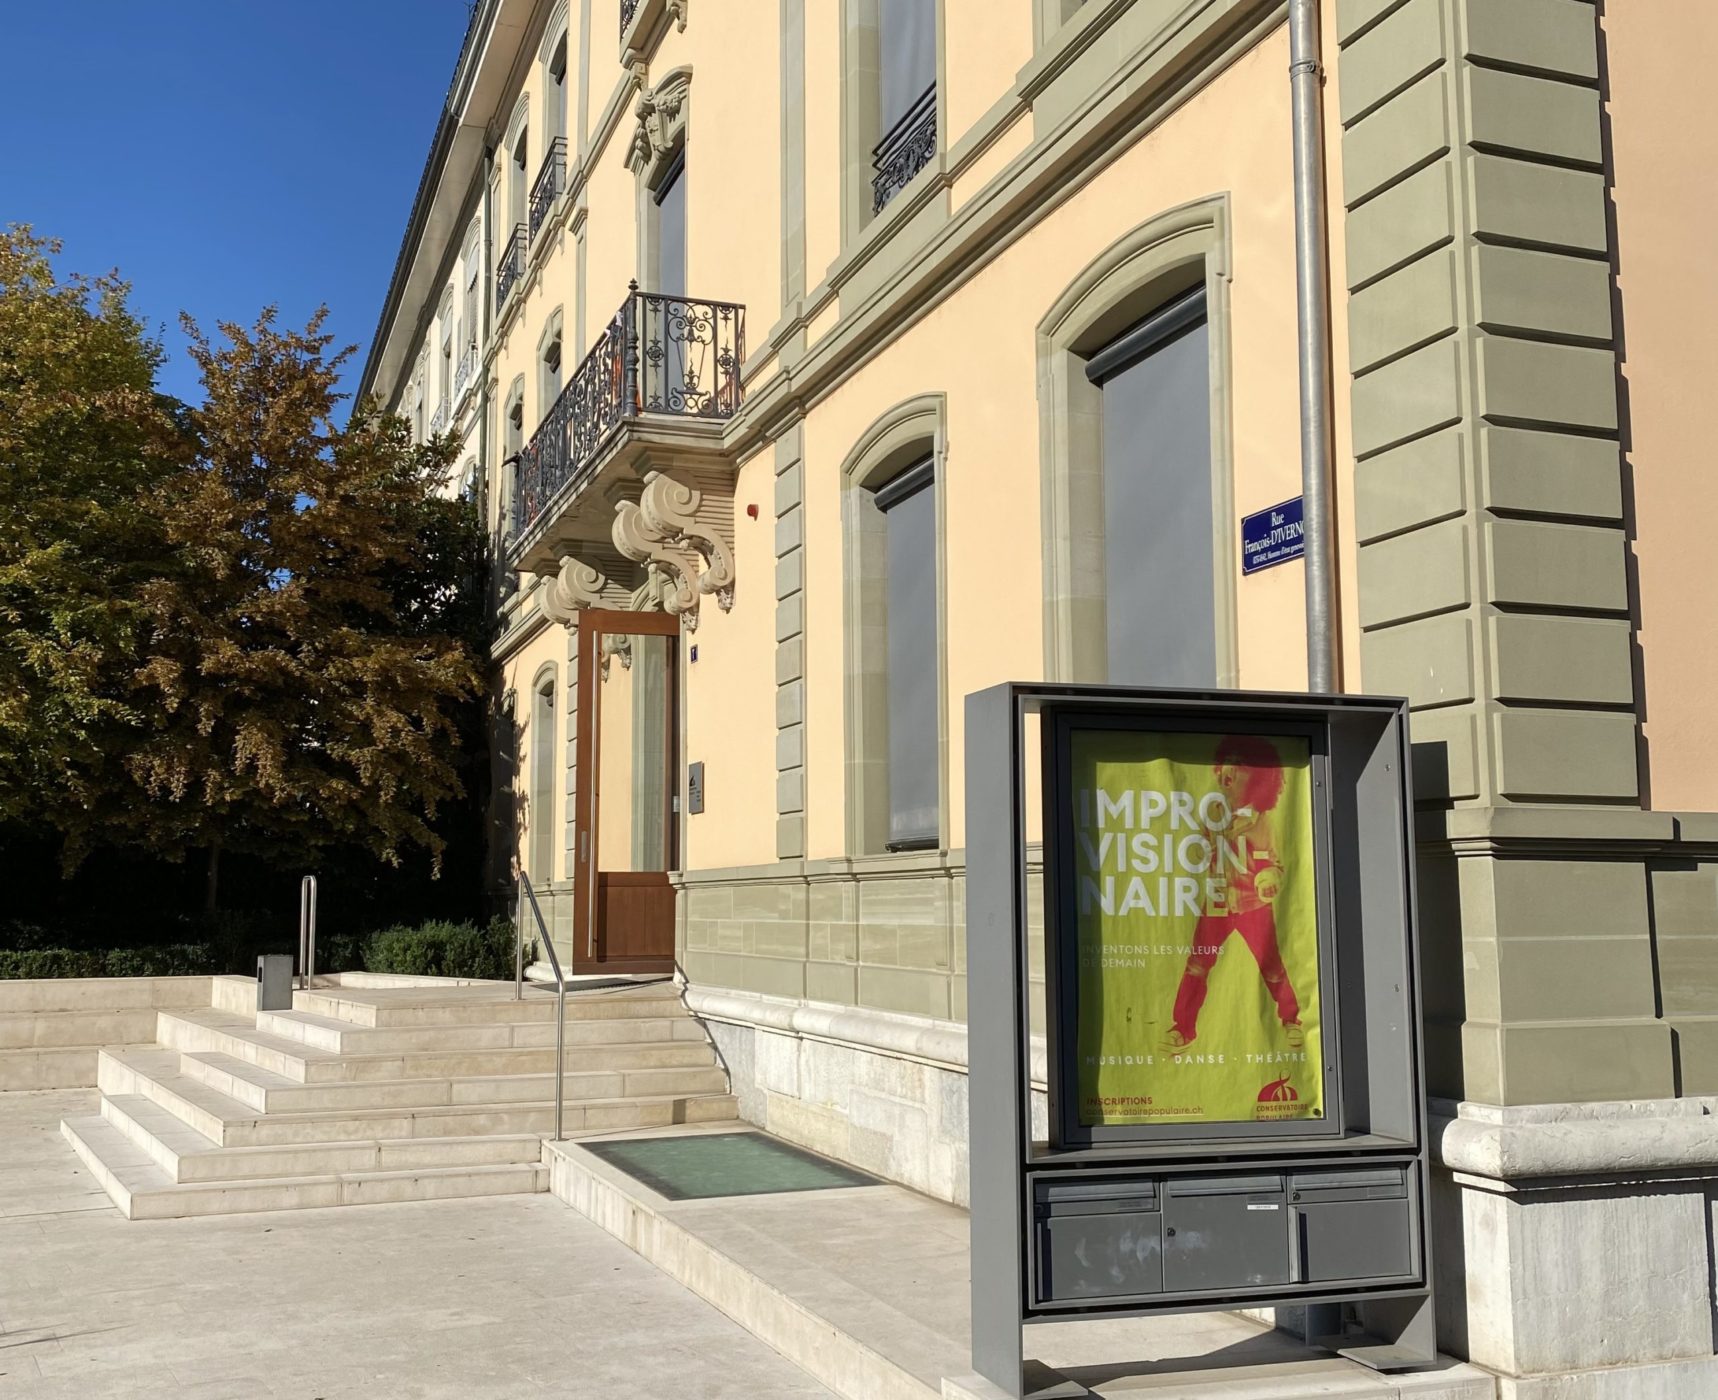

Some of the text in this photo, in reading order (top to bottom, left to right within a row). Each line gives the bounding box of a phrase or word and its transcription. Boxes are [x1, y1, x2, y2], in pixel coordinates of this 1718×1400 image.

[1271, 512, 1285, 526] Rue
[1080, 788, 1252, 832] IMPRO-
[1079, 832, 1269, 875] VISION-
[1081, 875, 1229, 918] NAIRE
[1082, 945, 1225, 955] INVENTONS LES VALEURS
[1082, 958, 1146, 968] DE DEMAIN
[1086, 1055, 1154, 1065] MUSIQUE
[1174, 1054, 1225, 1064] DANSE
[1086, 1097, 1153, 1105] INSCRIPTIONS
[1086, 1106, 1204, 1116] conservatoirepopulaire.ch
[1256, 1104, 1308, 1112] CONSERVATOIRE
